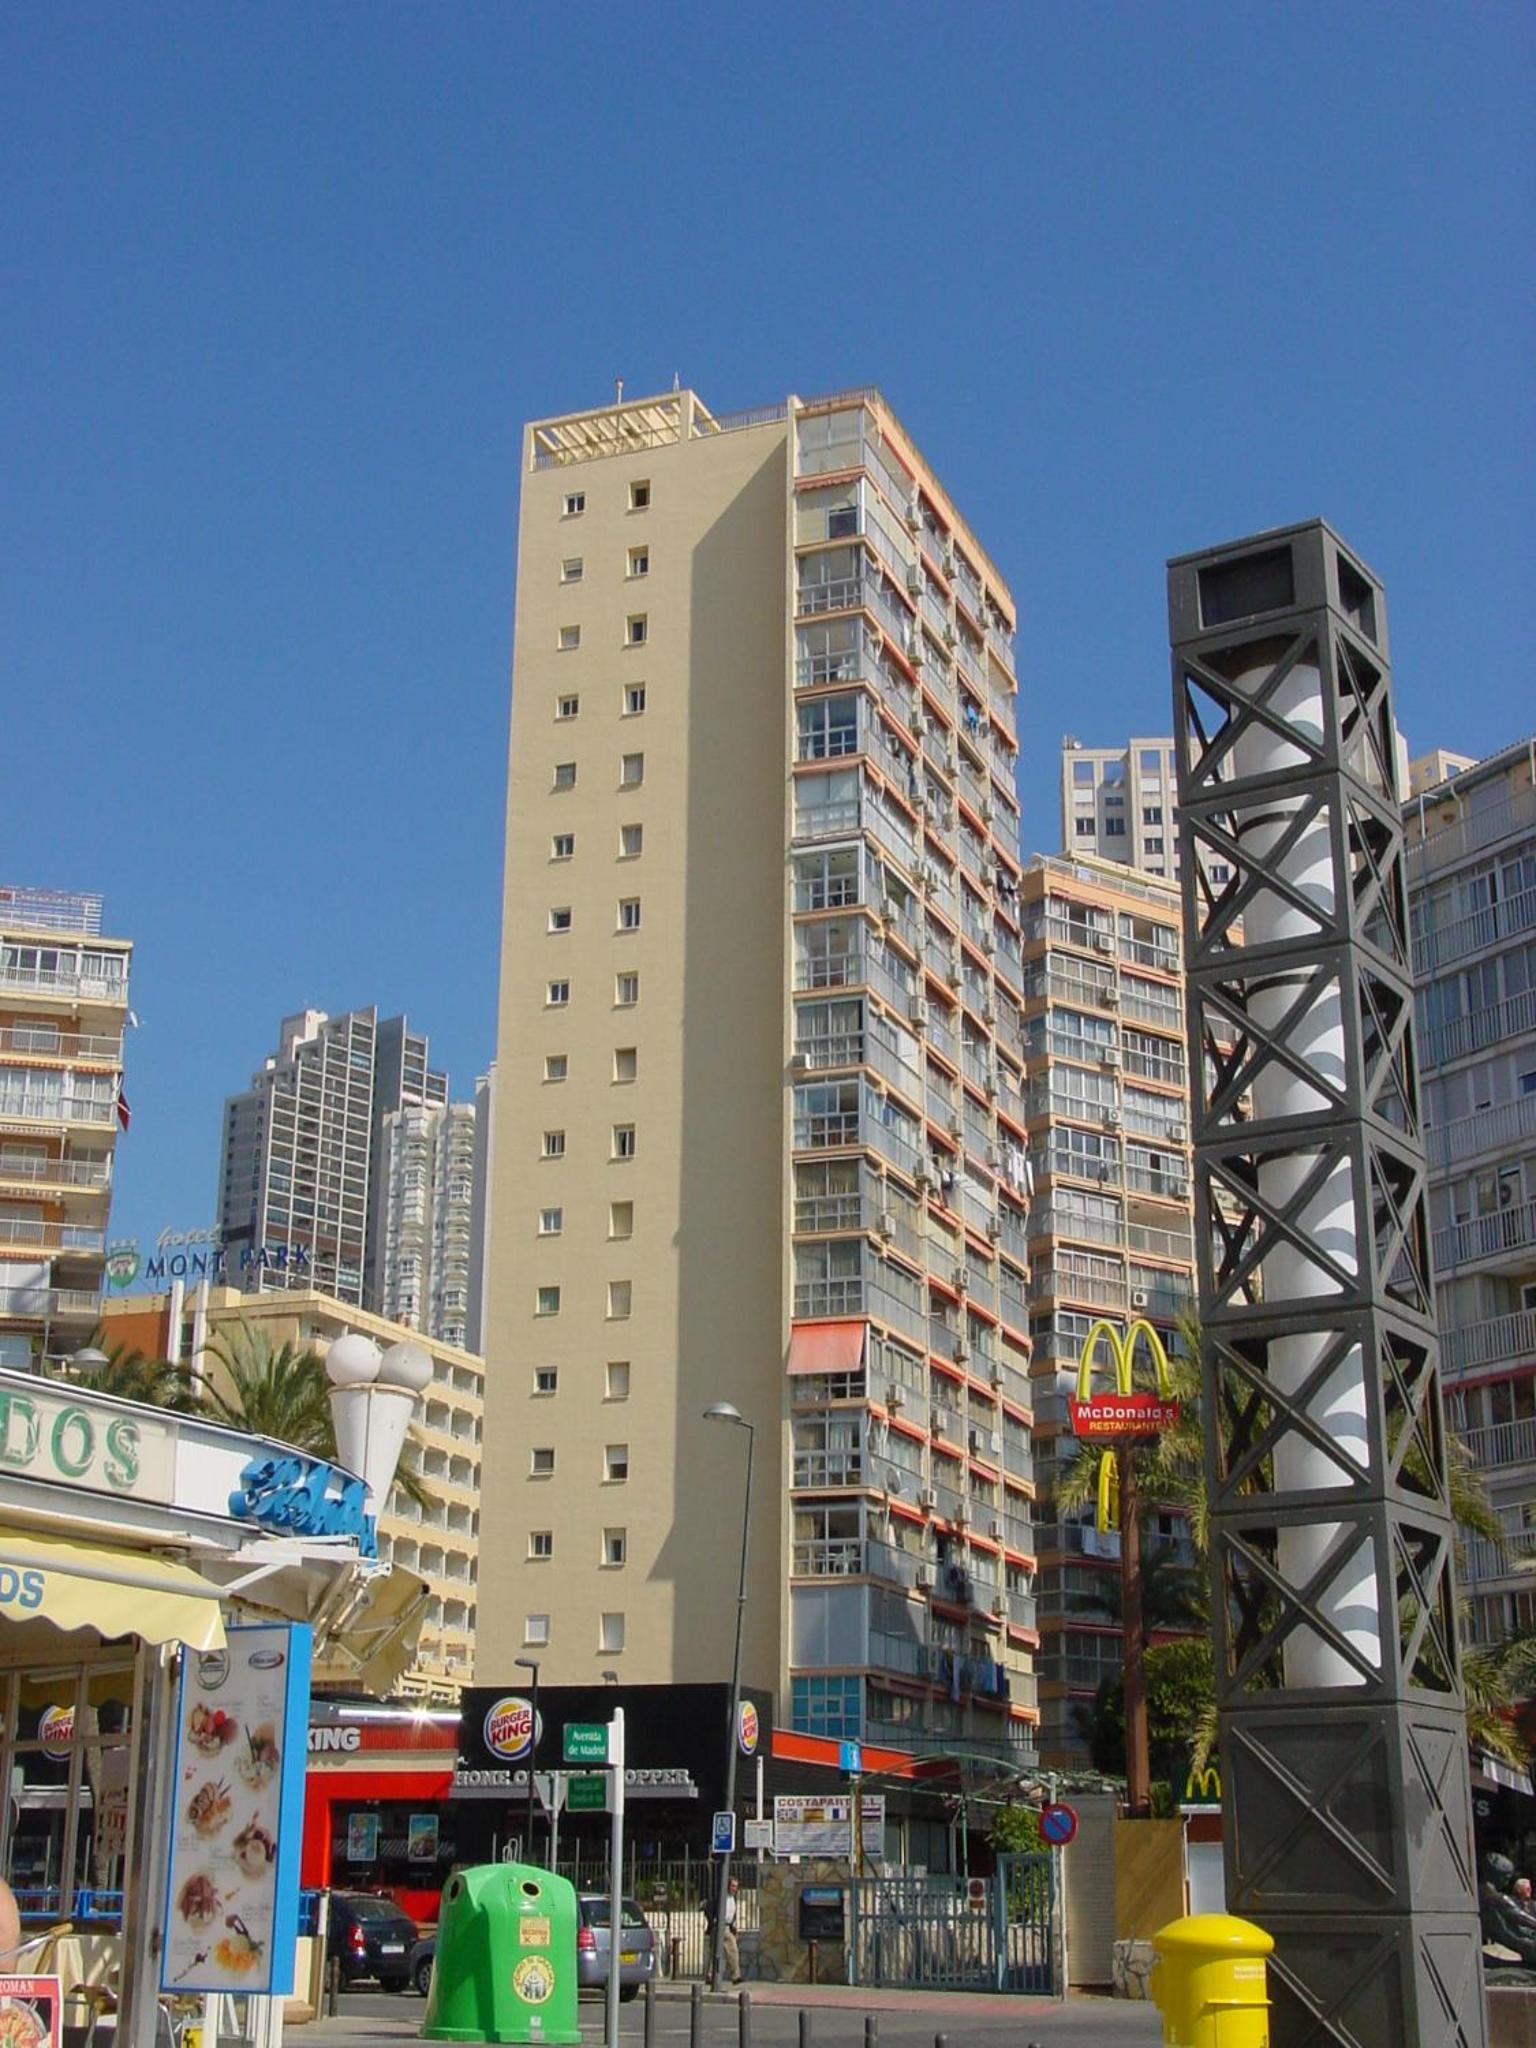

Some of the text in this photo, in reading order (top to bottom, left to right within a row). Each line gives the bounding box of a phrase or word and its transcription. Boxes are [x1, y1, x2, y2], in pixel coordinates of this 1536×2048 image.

[145, 1250, 226, 1280] MONT
[240, 1242, 311, 1272] PARK
[1077, 1406, 1174, 1420] McDonald's
[44, 1716, 75, 1733] BURGE
[490, 1709, 531, 1730] BURGER
[490, 1720, 533, 1747] KING
[572, 1730, 602, 1742] Avenida
[568, 1744, 606, 1756] de Madrid
